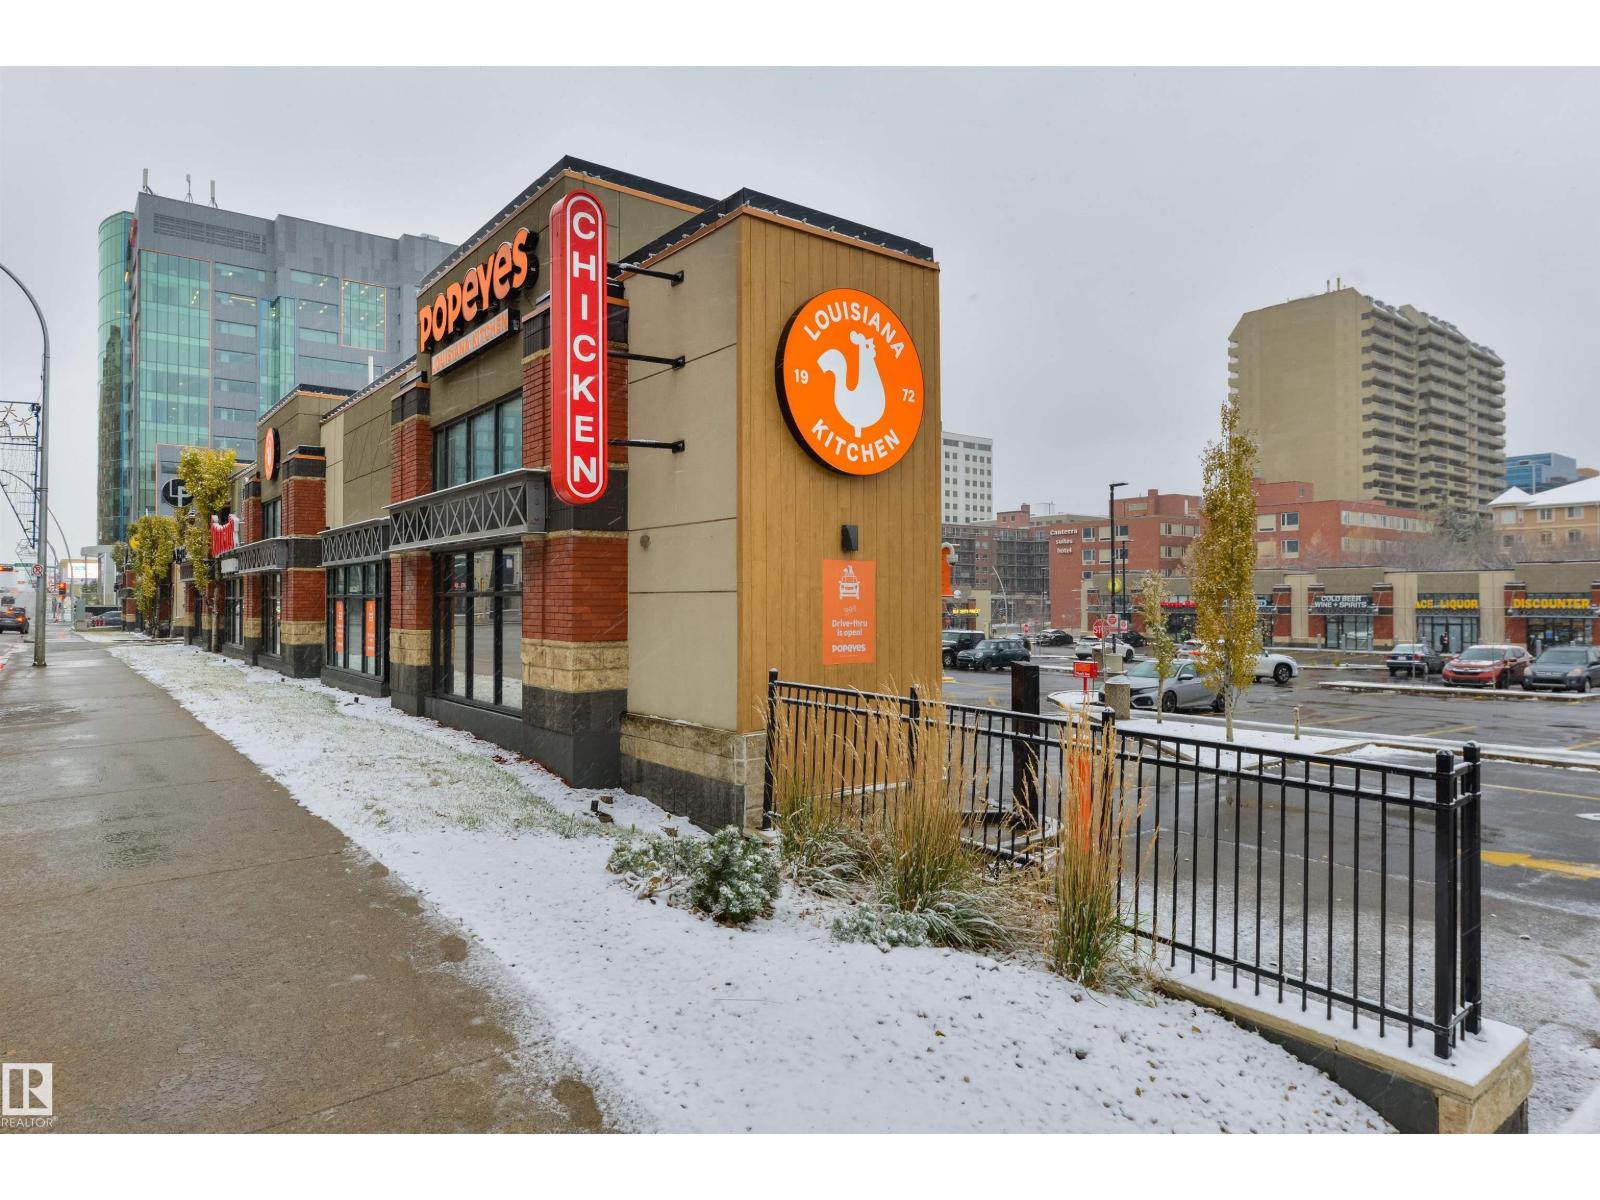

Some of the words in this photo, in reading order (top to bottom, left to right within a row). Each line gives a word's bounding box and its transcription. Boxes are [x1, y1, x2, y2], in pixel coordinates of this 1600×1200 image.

[803, 300, 906, 359] LOUISIANA
[571, 211, 598, 484] CHICKEN
[793, 368, 809, 385] 19
[902, 388, 916, 403] 72
[811, 418, 901, 463] KITCHEN
[1414, 599, 1433, 609] ACE
[1440, 599, 1479, 610] LIQUOR
[1512, 598, 1590, 609] DISCOUNTER
[832, 619, 868, 628] Drive-thru
